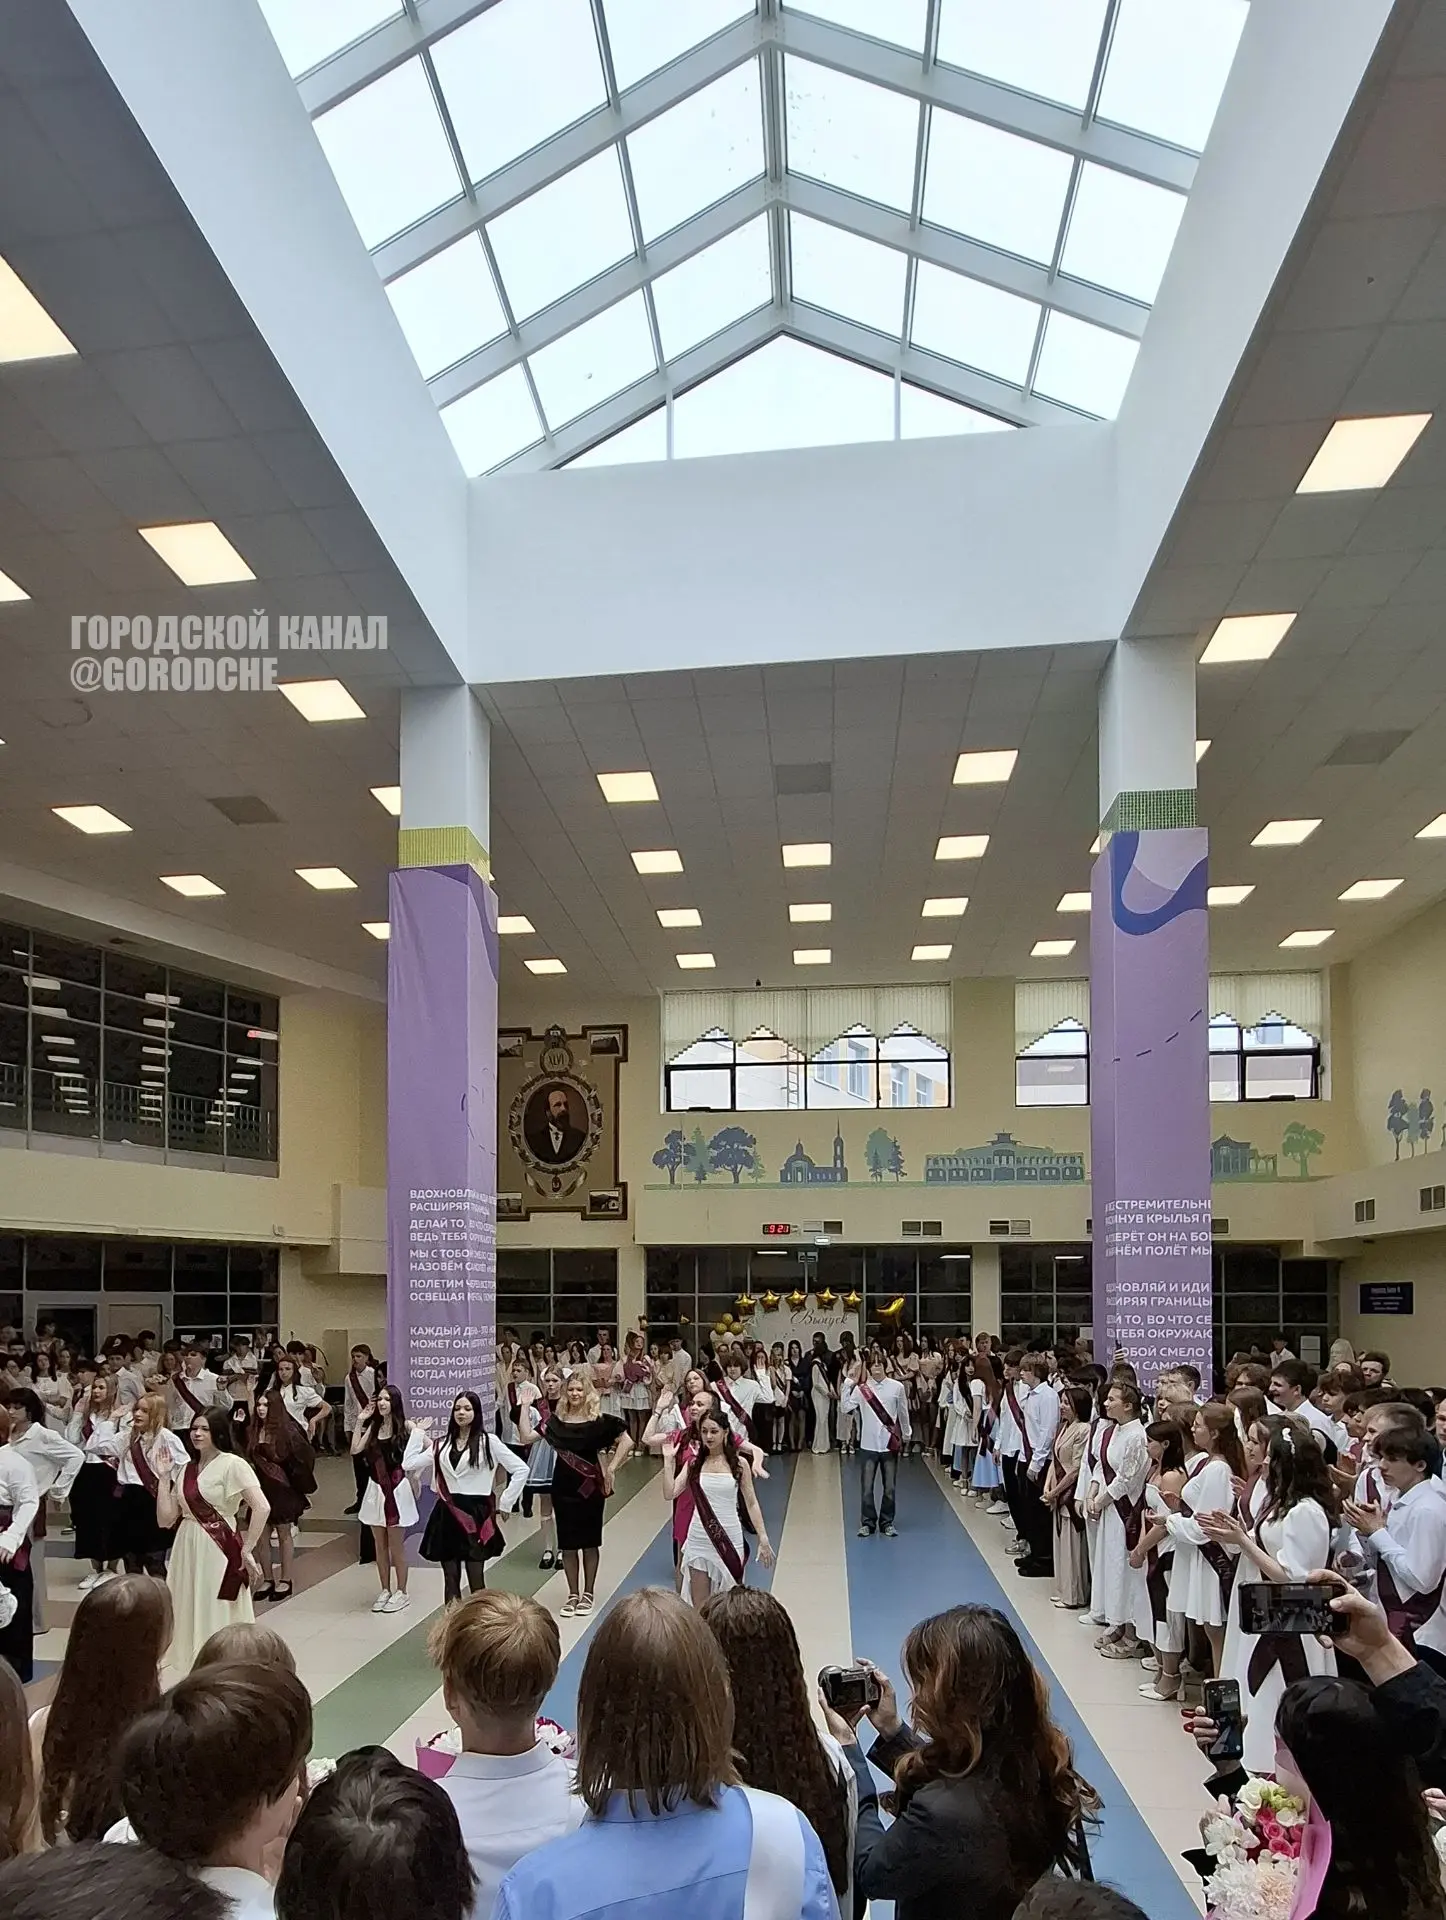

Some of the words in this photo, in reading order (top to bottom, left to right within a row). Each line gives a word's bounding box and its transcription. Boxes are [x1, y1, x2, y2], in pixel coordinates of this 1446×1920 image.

[409, 1202, 471, 1212] РАСШИРЯЯ
[409, 1218, 448, 1230] ДЕЛАЙ
[450, 1219, 467, 1230] ТО,
[1146, 1213, 1200, 1224] КРЫЛЬЯ
[409, 1232, 439, 1243] ВЕДЬ
[440, 1232, 468, 1242] ТЕБЯ
[1147, 1232, 1167, 1242] ОН
[1169, 1232, 1188, 1242] НА
[409, 1249, 429, 1259] МЫ
[431, 1249, 438, 1259] С
[1145, 1244, 1188, 1256] ПОЛЁТ
[409, 1260, 463, 1271] НАЗОВЁМ
[409, 1279, 464, 1289] ПОЛЕТИМ
[1169, 1282, 1179, 1292] И
[1181, 1282, 1210, 1294] ИДИ
[409, 1292, 465, 1302] ОСВЕЩАЯ
[1124, 1314, 1144, 1326] ТО,
[1147, 1314, 1166, 1325] ВО
[1168, 1314, 1193, 1325] ЧТО
[409, 1325, 461, 1337] КАЖДЫЙ
[1116, 1328, 1145, 1339] ТЕБЯ
[409, 1339, 450, 1349] МОЖЕТ
[453, 1339, 469, 1349] ОН
[1160, 1347, 1205, 1357] СМЕЛО
[410, 1369, 446, 1380] КОГДА
[448, 1369, 472, 1380] МИР
[410, 1399, 454, 1409] ТОЛЬКО
